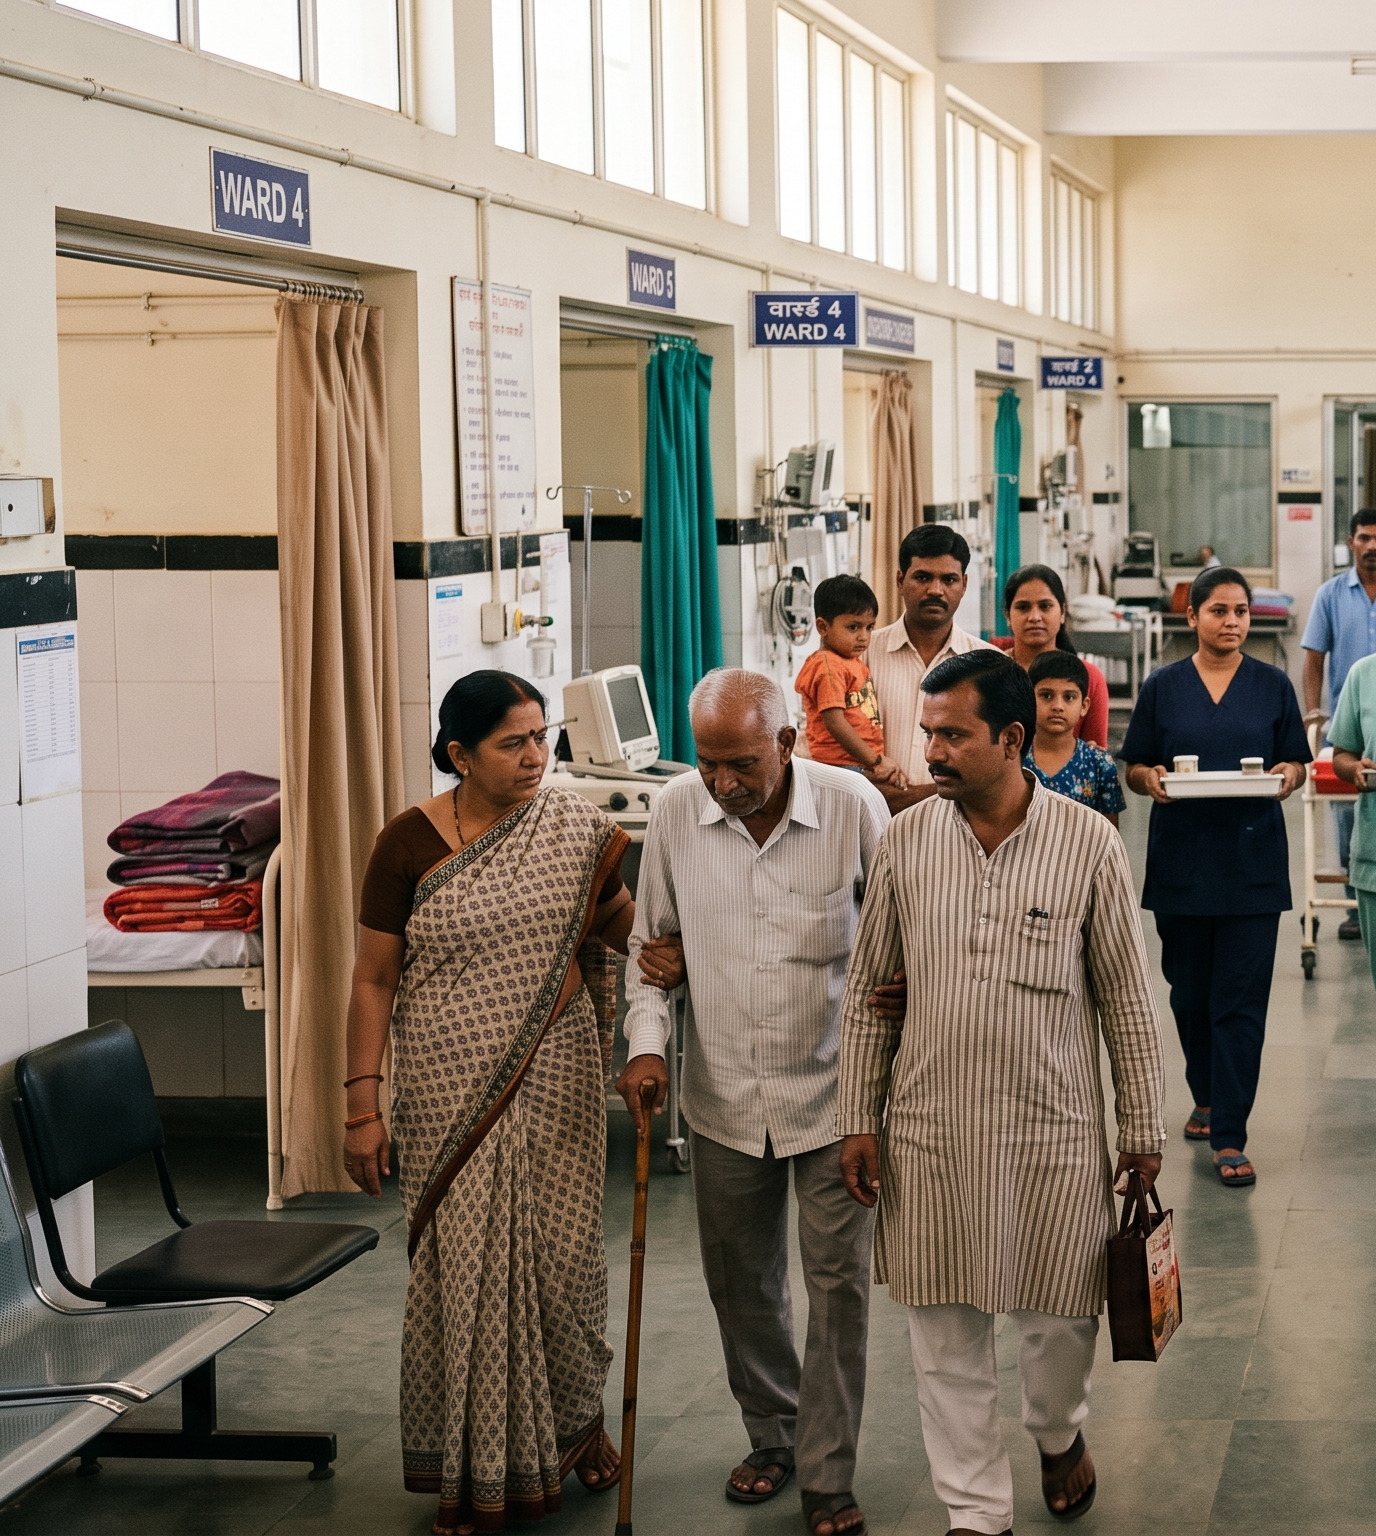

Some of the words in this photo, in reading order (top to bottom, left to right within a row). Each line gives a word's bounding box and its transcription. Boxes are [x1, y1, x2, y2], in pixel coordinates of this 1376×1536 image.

[219, 170, 287, 224] WARD
[291, 187, 304, 228] 4
[631, 261, 665, 297] WARD
[666, 269, 674, 299] 5
[827, 300, 842, 319] 4
[763, 323, 828, 341] WARD
[833, 323, 847, 341] 4
[1088, 374, 1098, 387] 4
